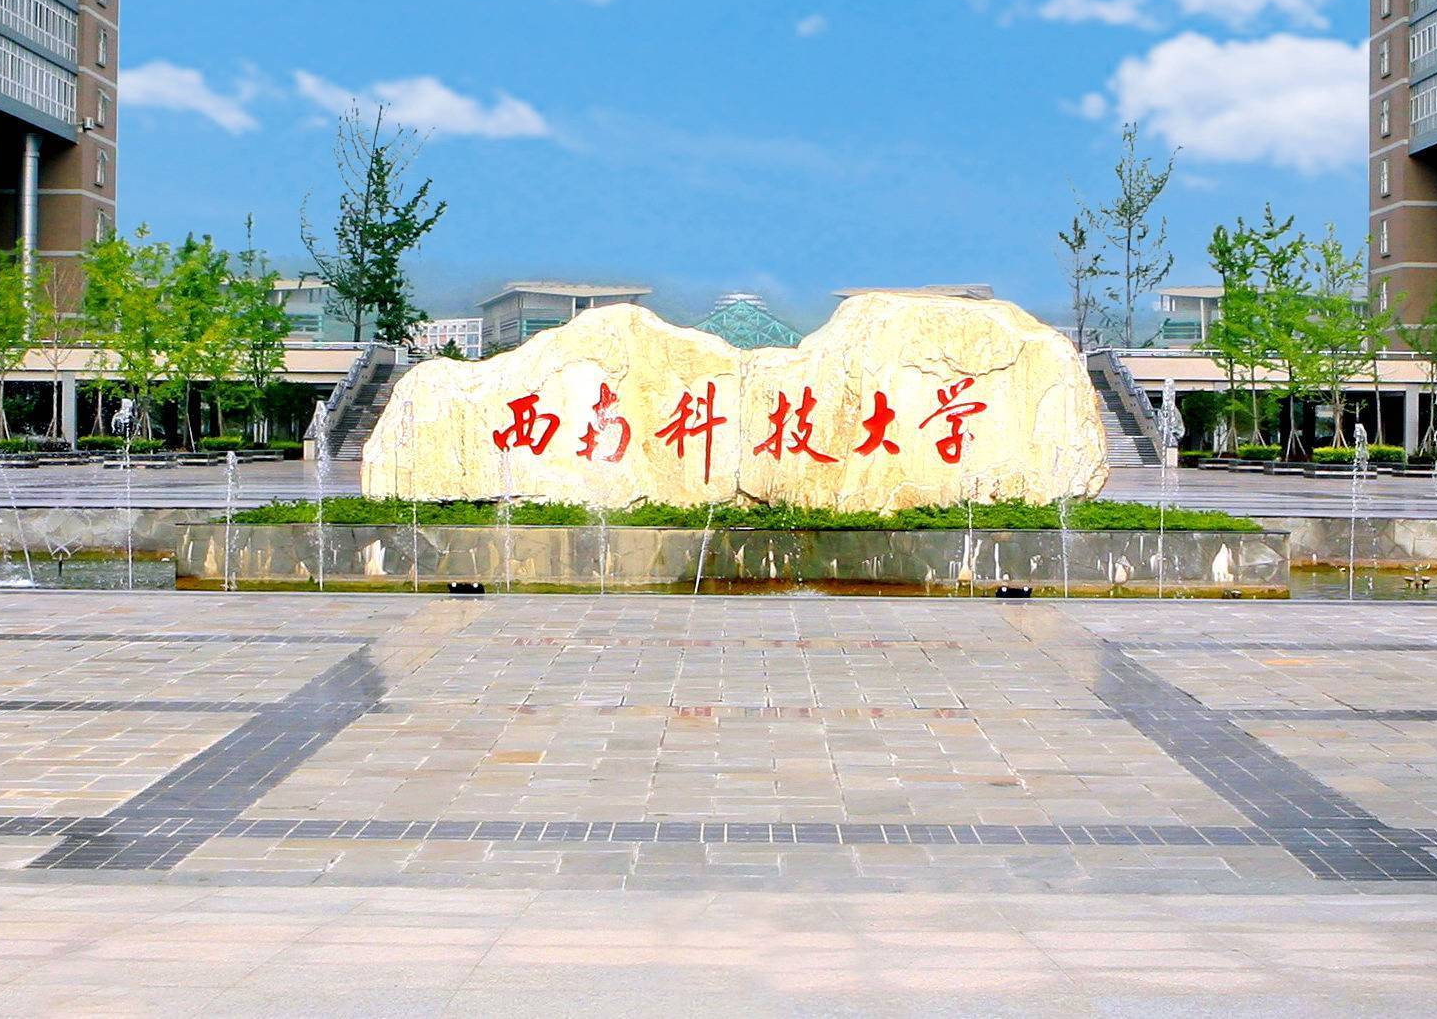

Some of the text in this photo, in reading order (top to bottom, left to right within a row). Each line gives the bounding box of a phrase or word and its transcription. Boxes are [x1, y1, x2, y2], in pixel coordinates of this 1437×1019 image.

[492, 378, 987, 484] 西南科技大学
